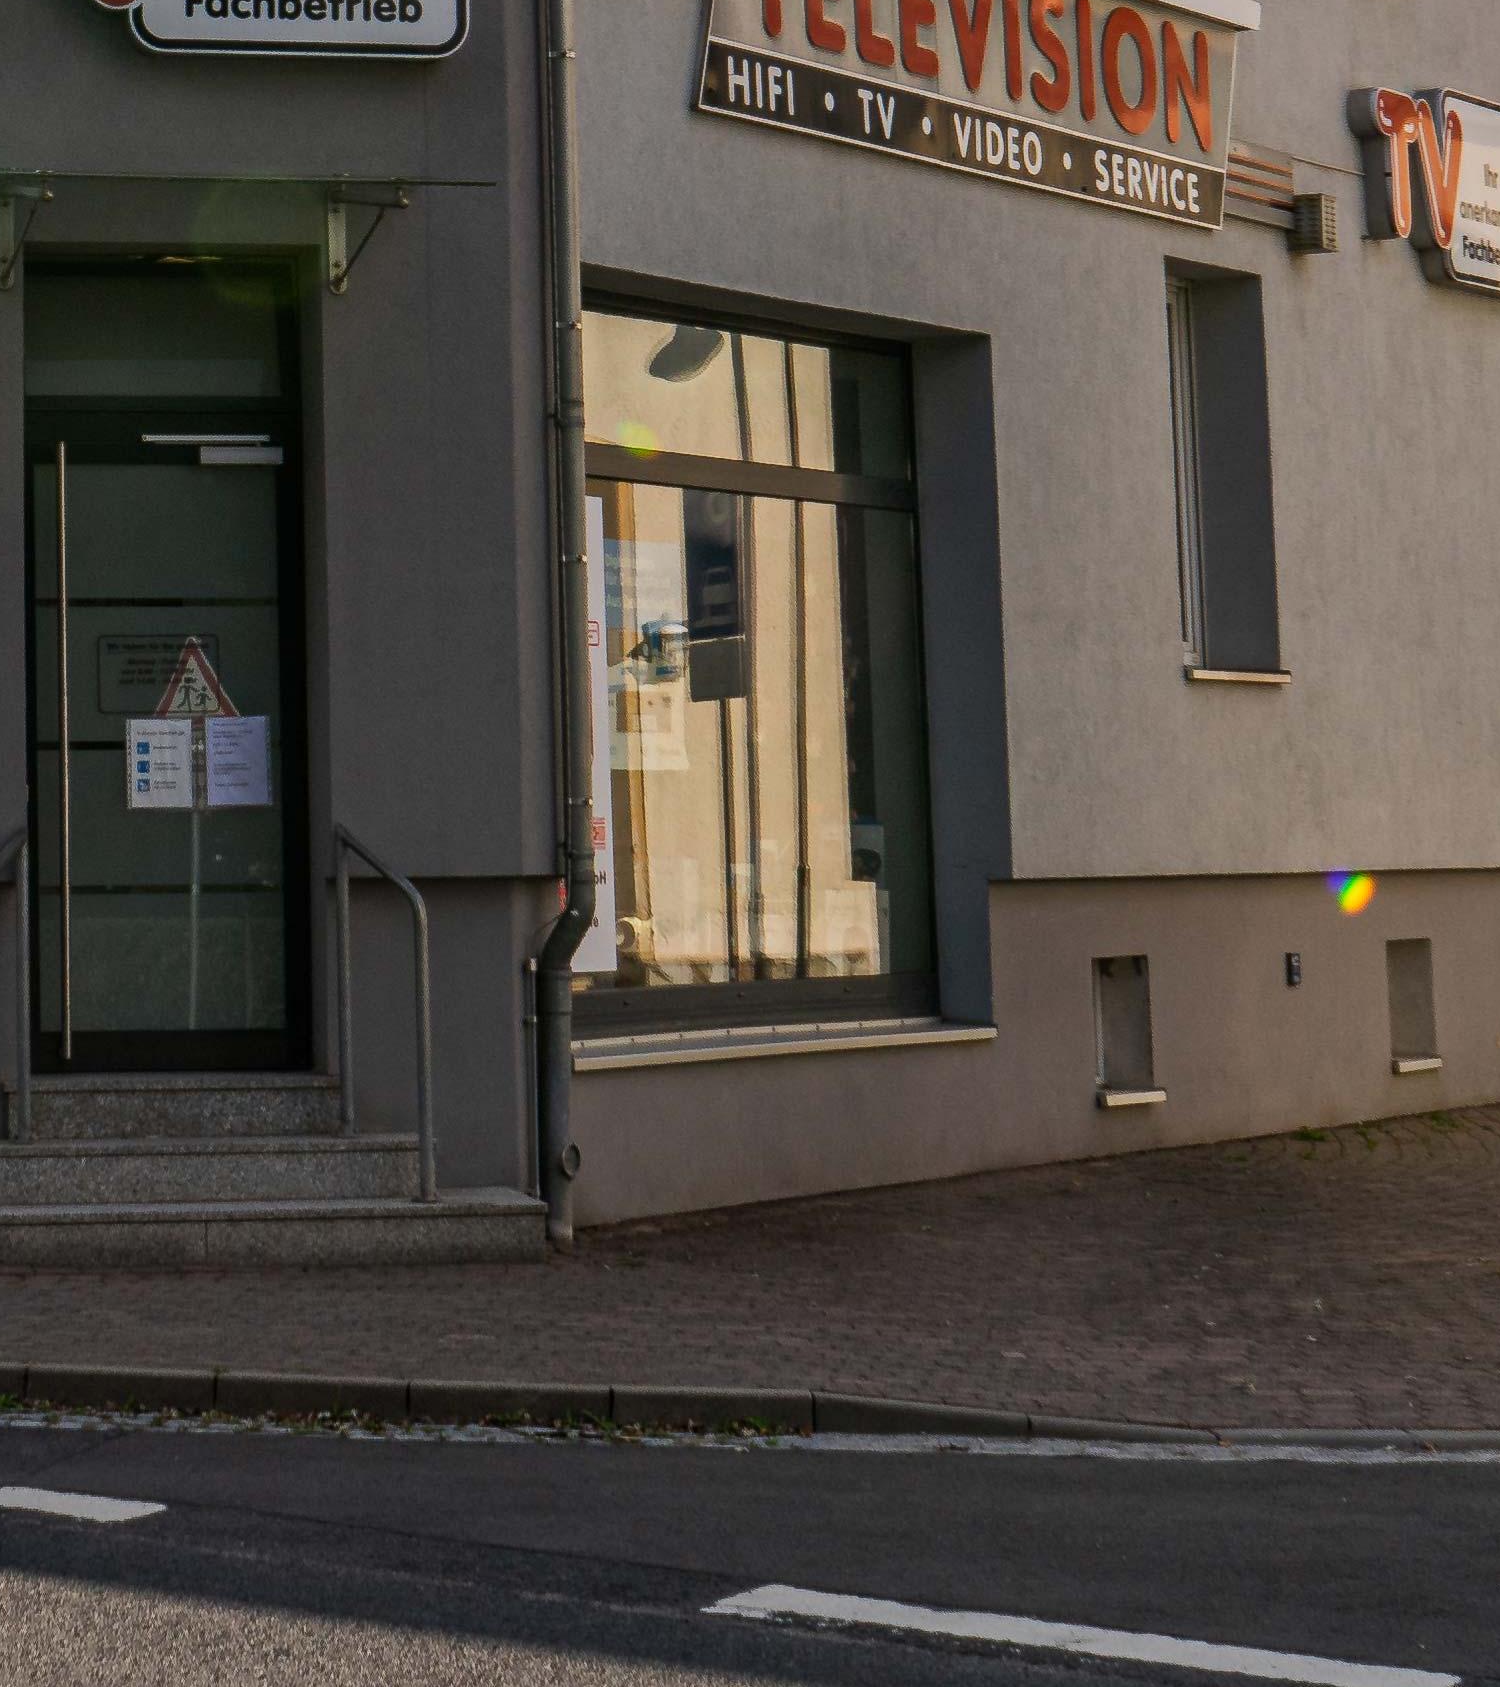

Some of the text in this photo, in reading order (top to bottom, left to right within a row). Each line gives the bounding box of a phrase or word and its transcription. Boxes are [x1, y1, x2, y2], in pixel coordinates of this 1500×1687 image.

[727, 55, 1200, 215] HIFI TV VIDEO SERVICE
[1376, 88, 1464, 250] TV
